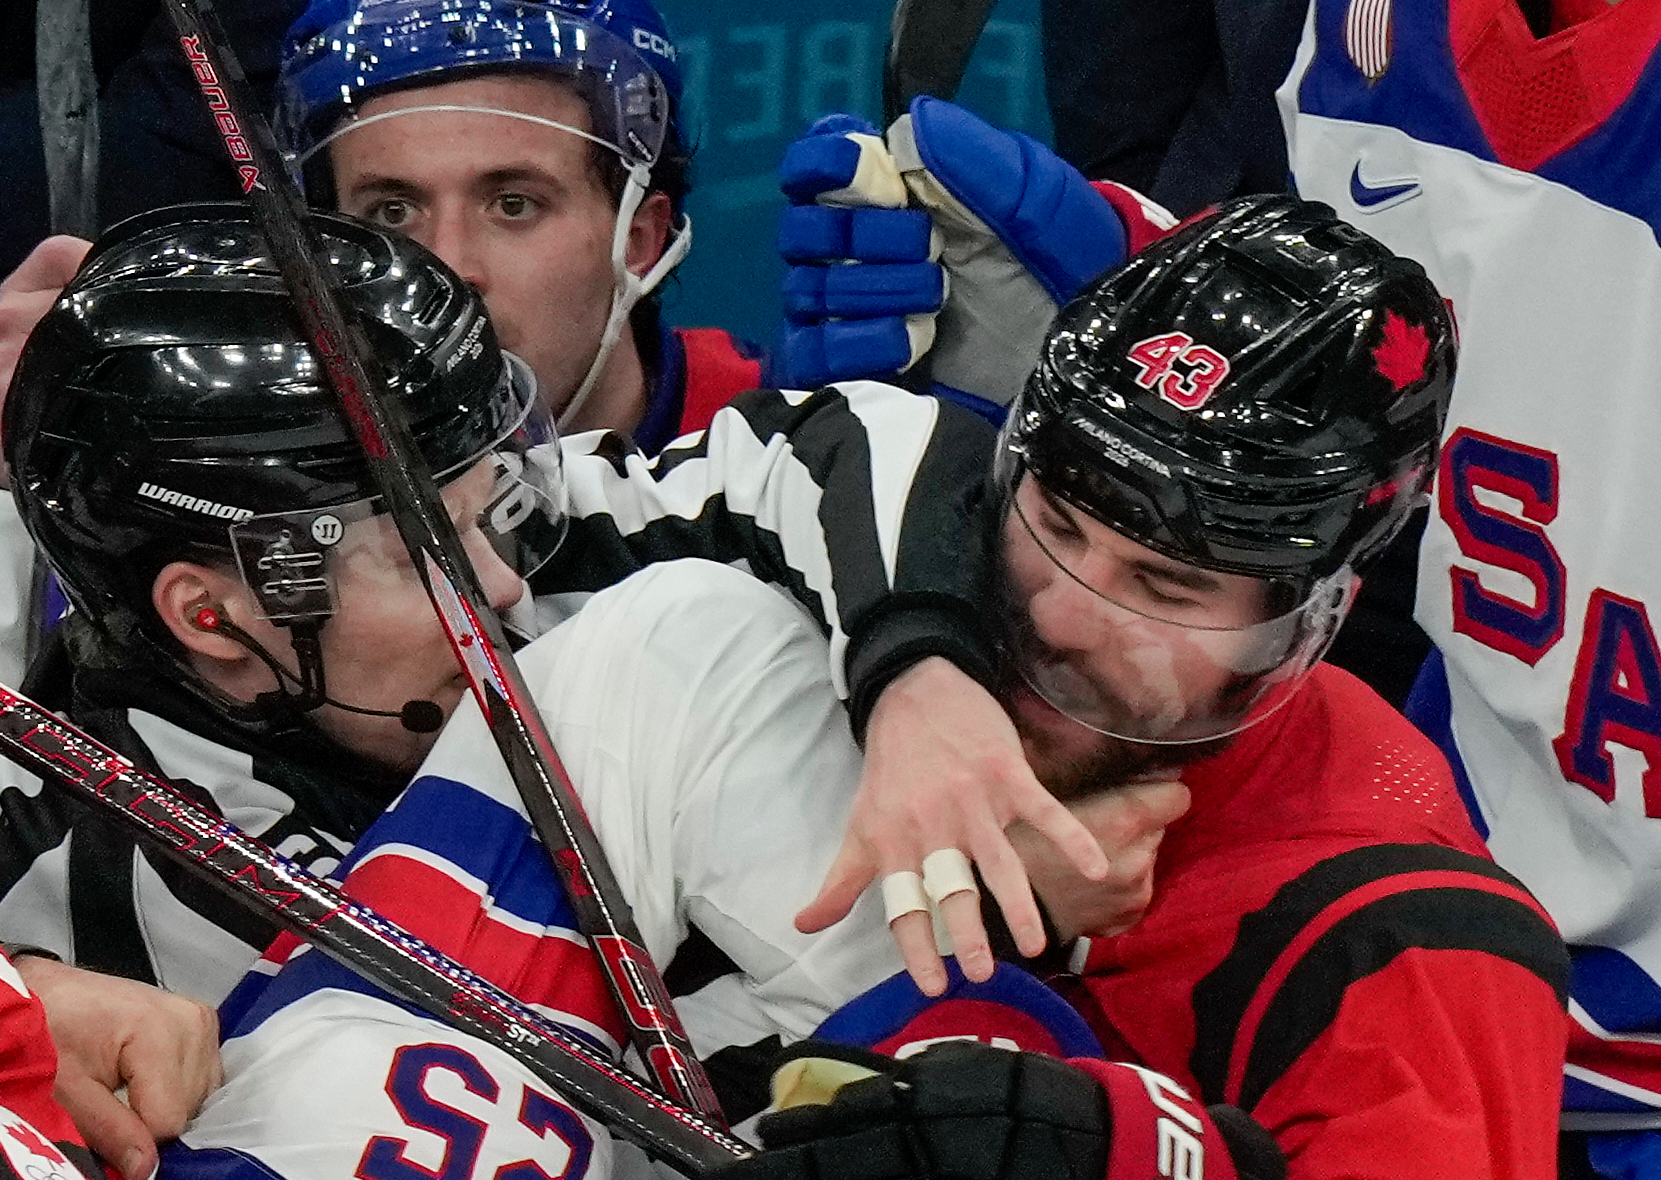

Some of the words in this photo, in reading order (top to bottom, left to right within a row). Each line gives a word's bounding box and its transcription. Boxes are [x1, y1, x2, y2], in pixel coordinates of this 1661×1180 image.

[1126, 331, 1230, 411] 43
[137, 481, 255, 523] WARRIOR
[1437, 424, 1661, 818] SA
